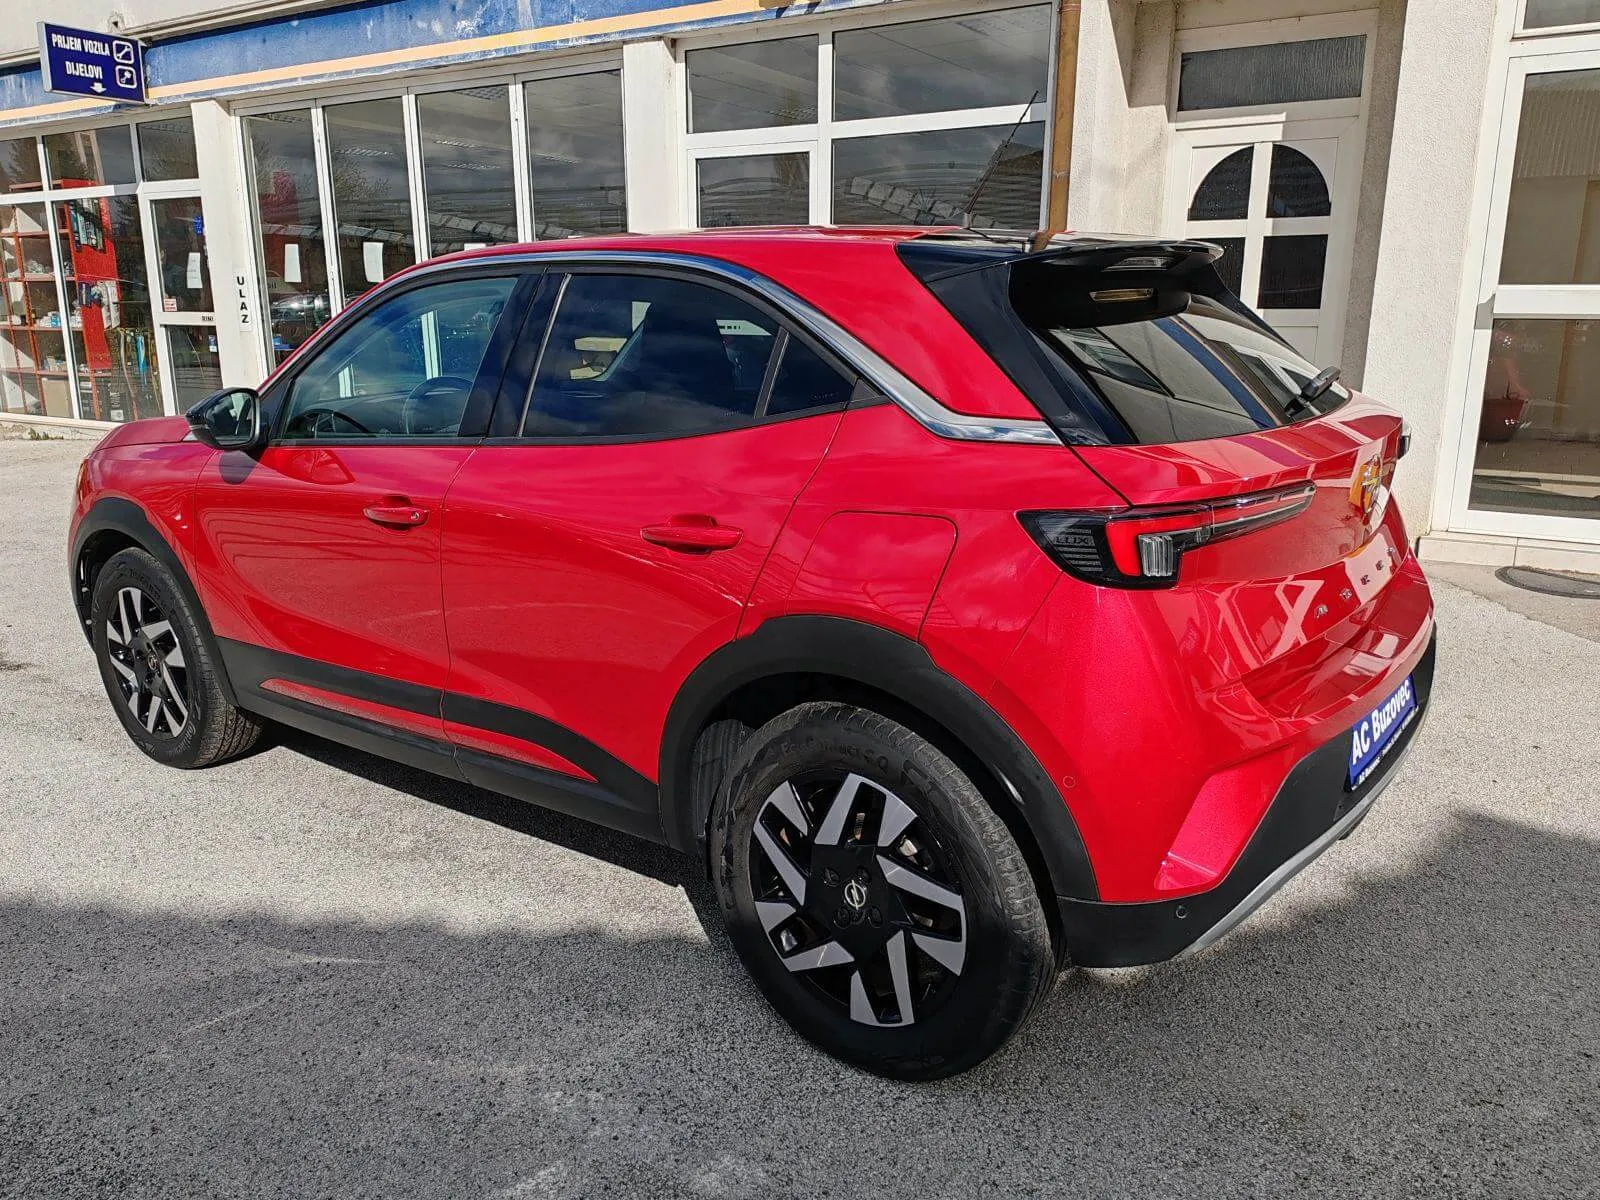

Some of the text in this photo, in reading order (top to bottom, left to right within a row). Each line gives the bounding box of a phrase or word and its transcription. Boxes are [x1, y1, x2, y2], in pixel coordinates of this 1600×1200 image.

[51, 33, 111, 57] PRIJEM VOZILA
[65, 60, 103, 80] DIJELOVI
[236, 275, 250, 324] ULAZ
[1352, 720, 1371, 766] AC
[1371, 679, 1411, 742] Buzovec
